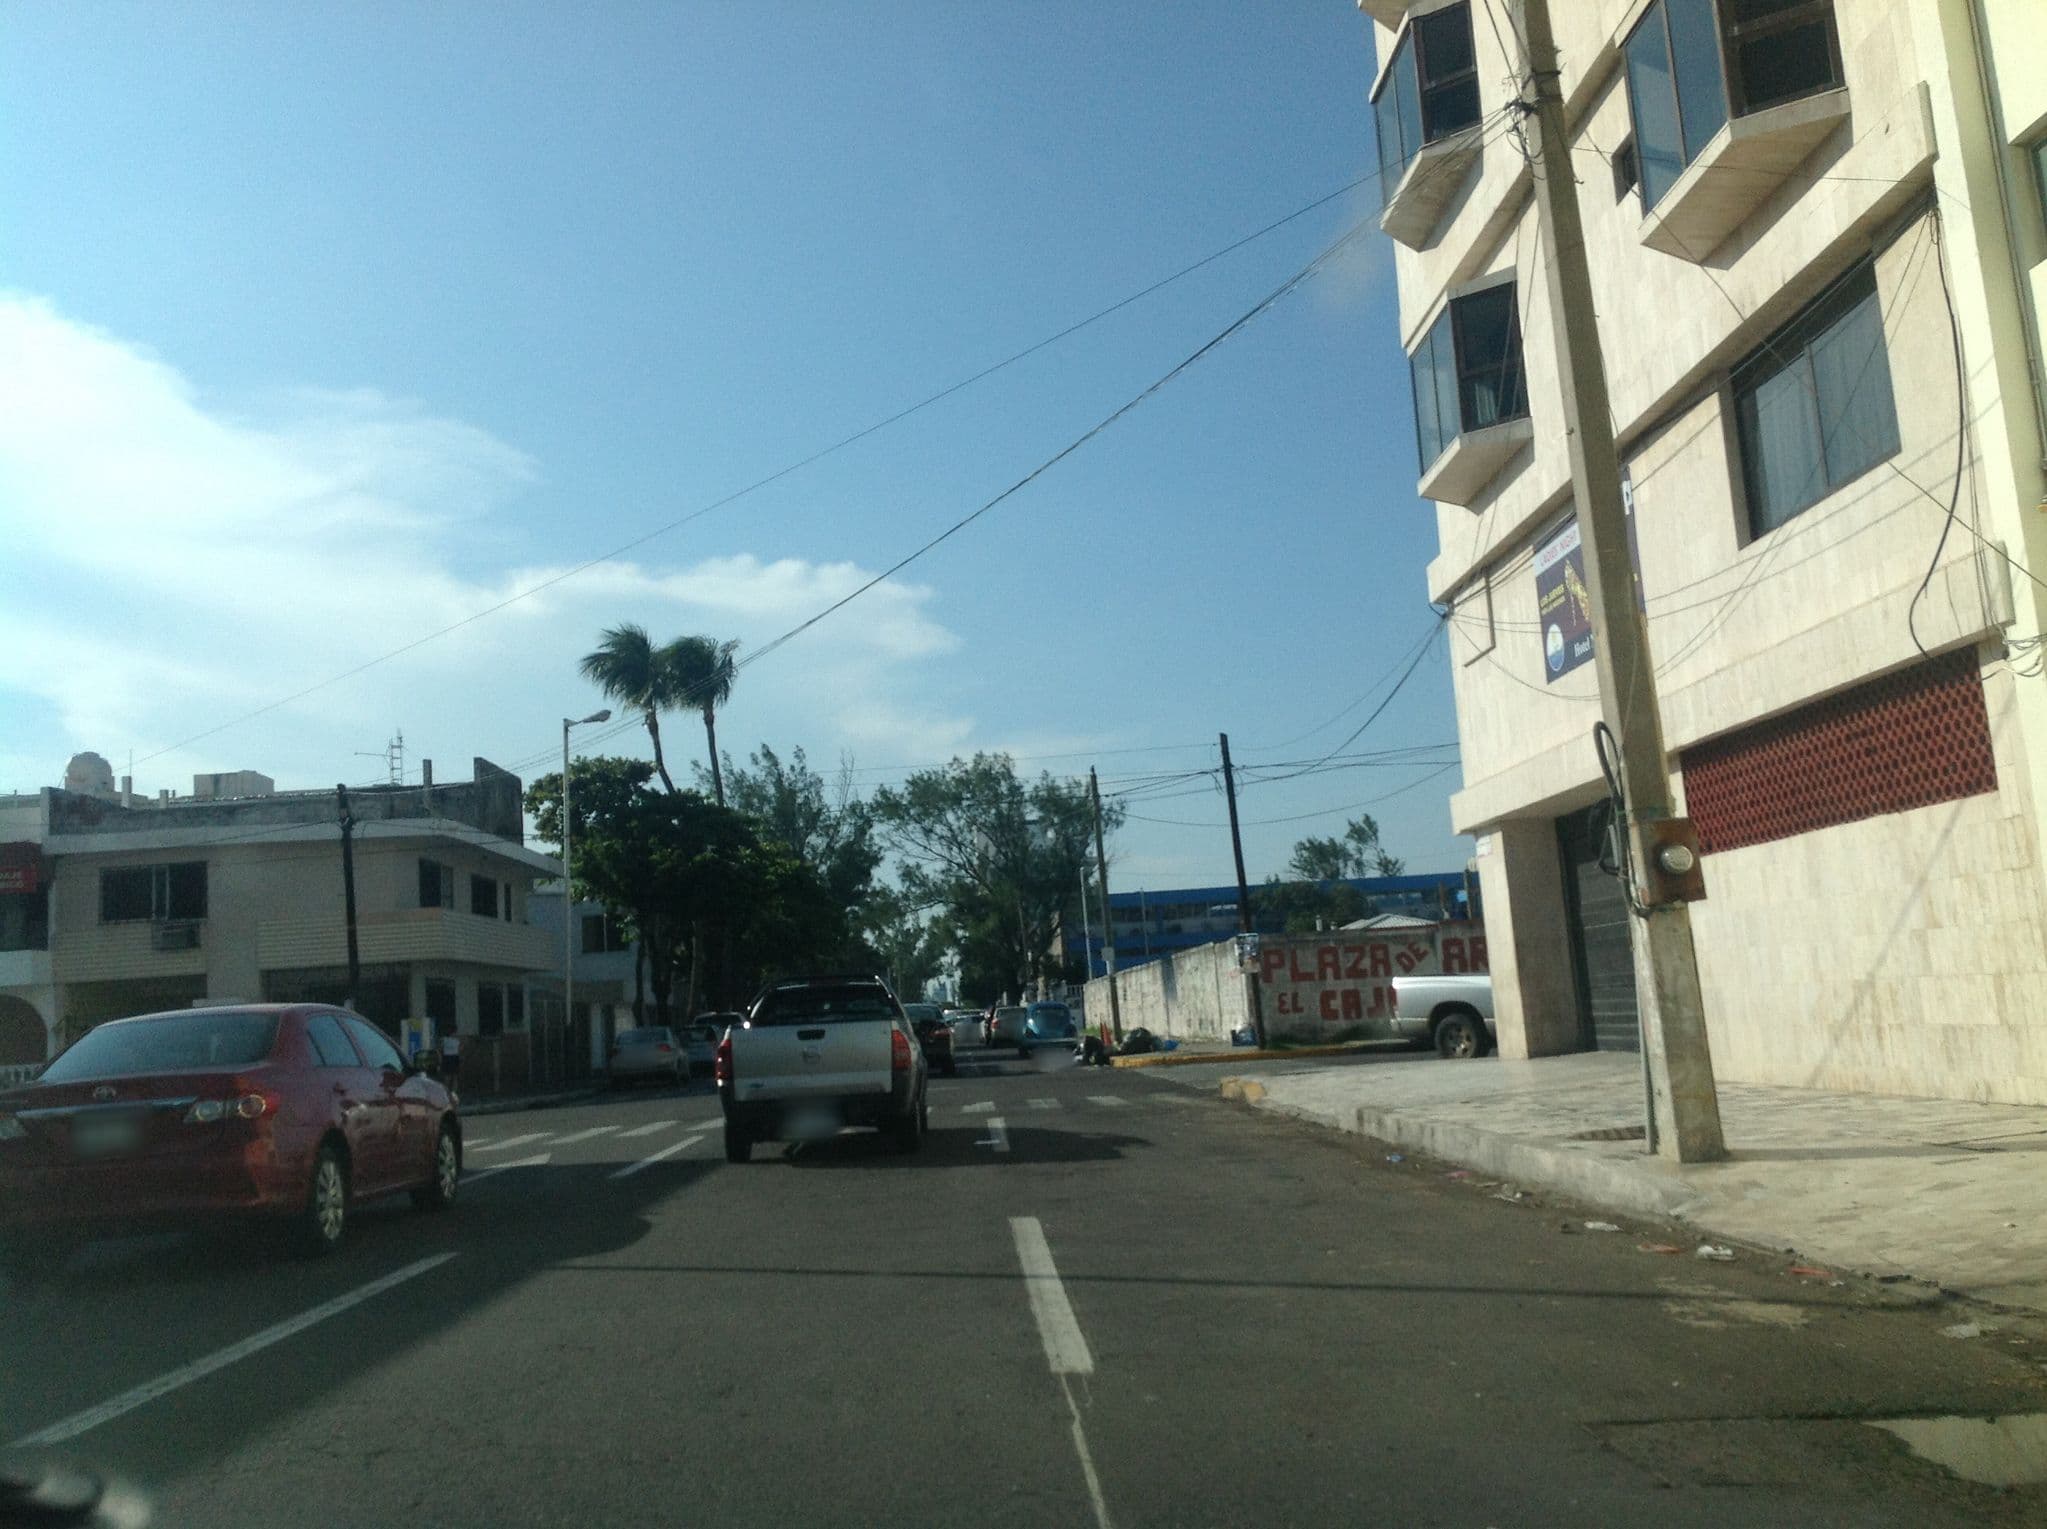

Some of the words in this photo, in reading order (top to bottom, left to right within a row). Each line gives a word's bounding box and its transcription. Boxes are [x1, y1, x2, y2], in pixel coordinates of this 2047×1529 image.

[1574, 636, 1590, 657] Hotel
[1262, 943, 1392, 983] PLAZA
[1395, 941, 1430, 974] DE
[1277, 992, 1304, 1015] EL
